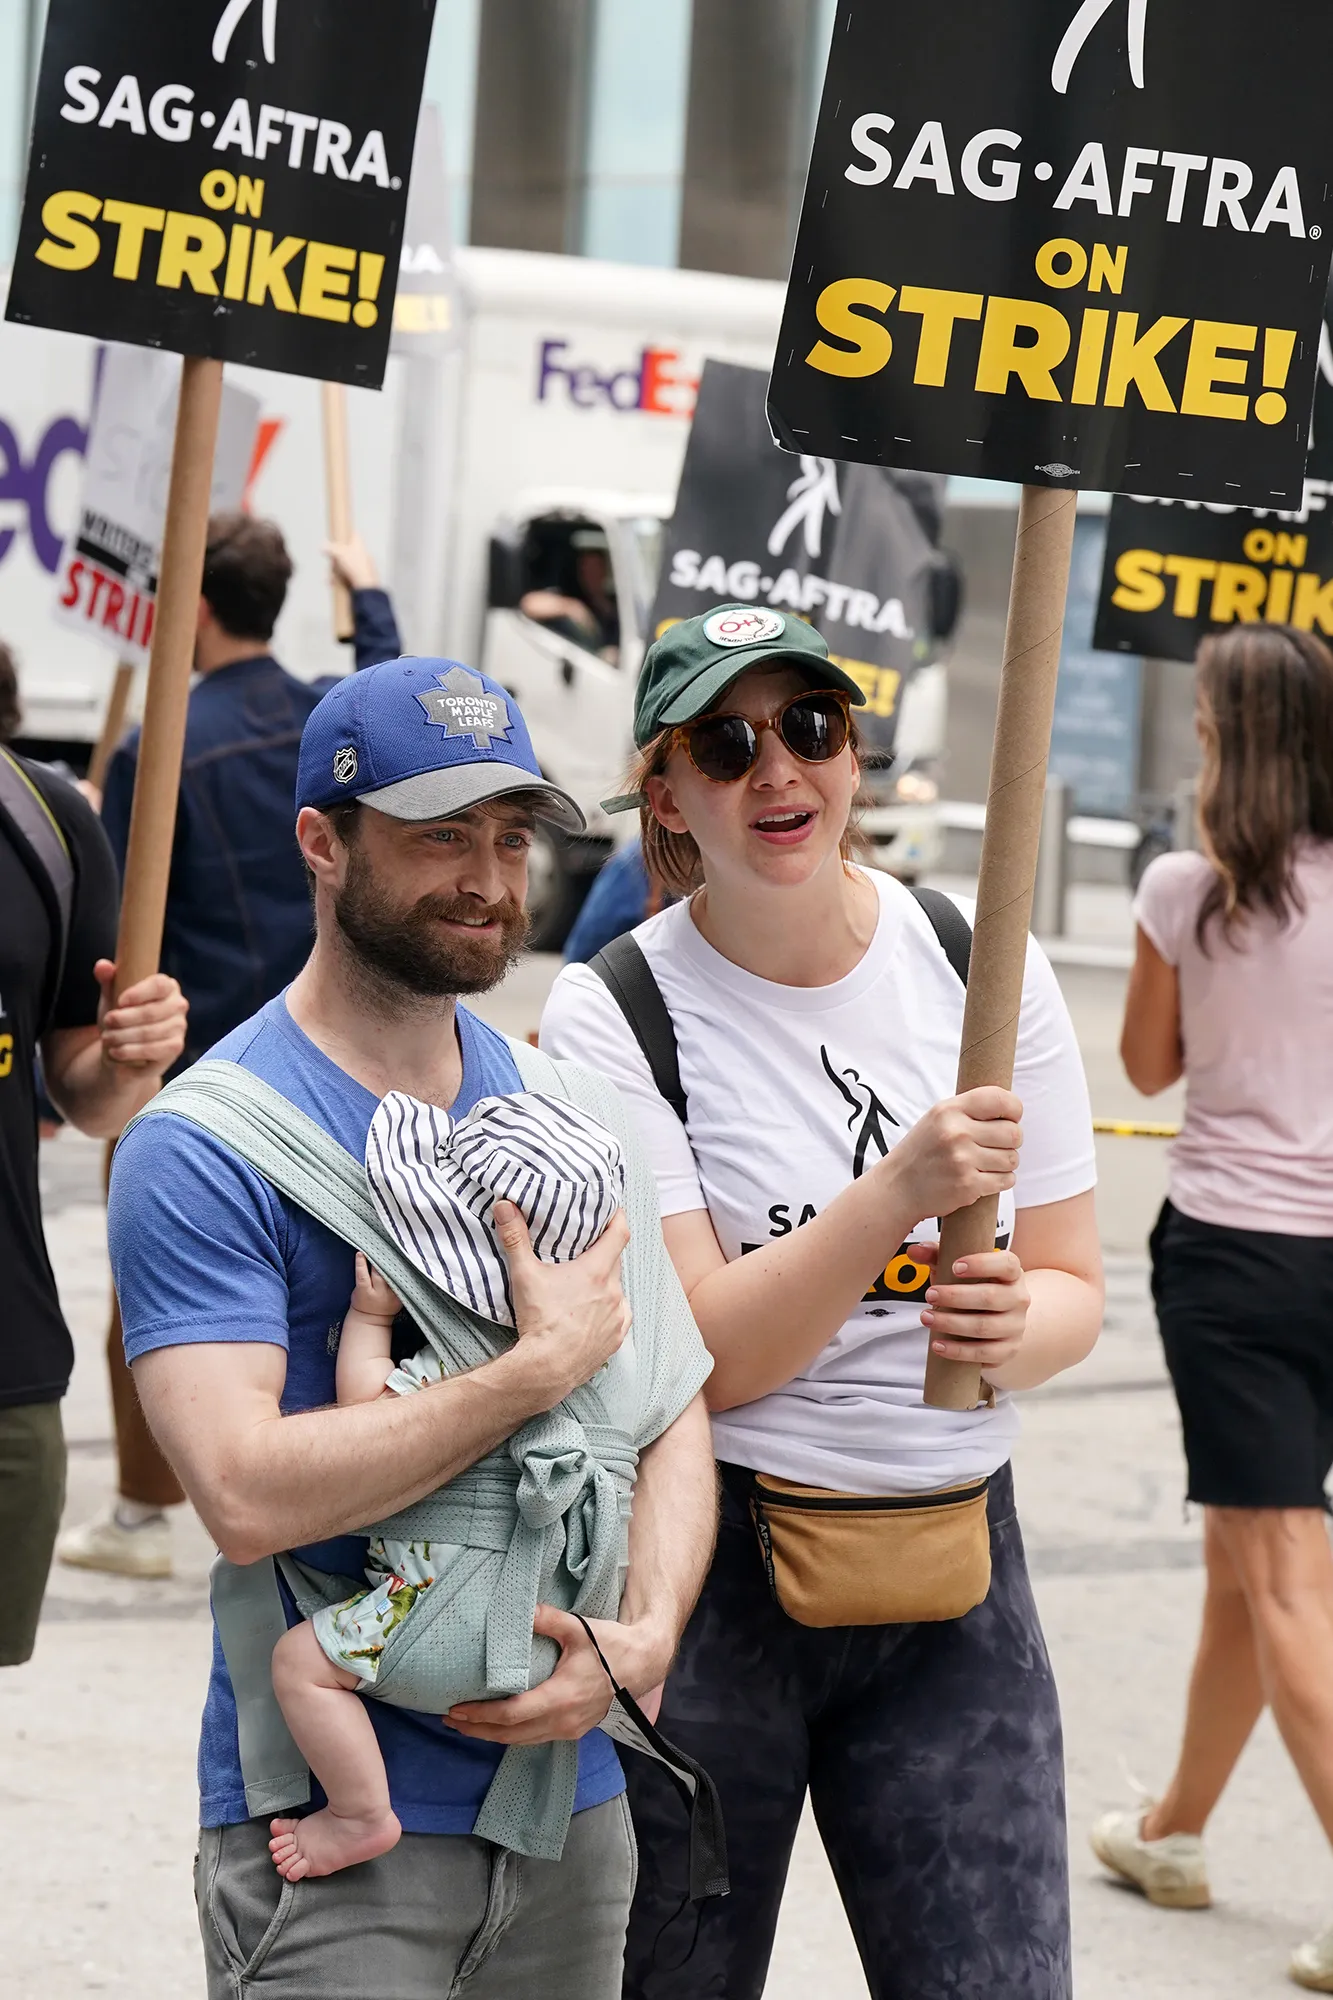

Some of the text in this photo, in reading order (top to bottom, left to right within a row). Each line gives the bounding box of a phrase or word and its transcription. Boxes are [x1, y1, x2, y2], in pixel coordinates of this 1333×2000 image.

[200, 169, 265, 219] ON
[34, 190, 386, 328] STRIKE!
[1034, 237, 1129, 295] ON
[804, 277, 1297, 425] STRIKE!
[1243, 529, 1308, 568] ON
[60, 555, 156, 651] STRI
[1111, 548, 1333, 637] STRIK
[437, 696, 498, 711] TORONTO
[451, 706, 494, 719] MAPLE
[458, 716, 495, 728] LEAFS
